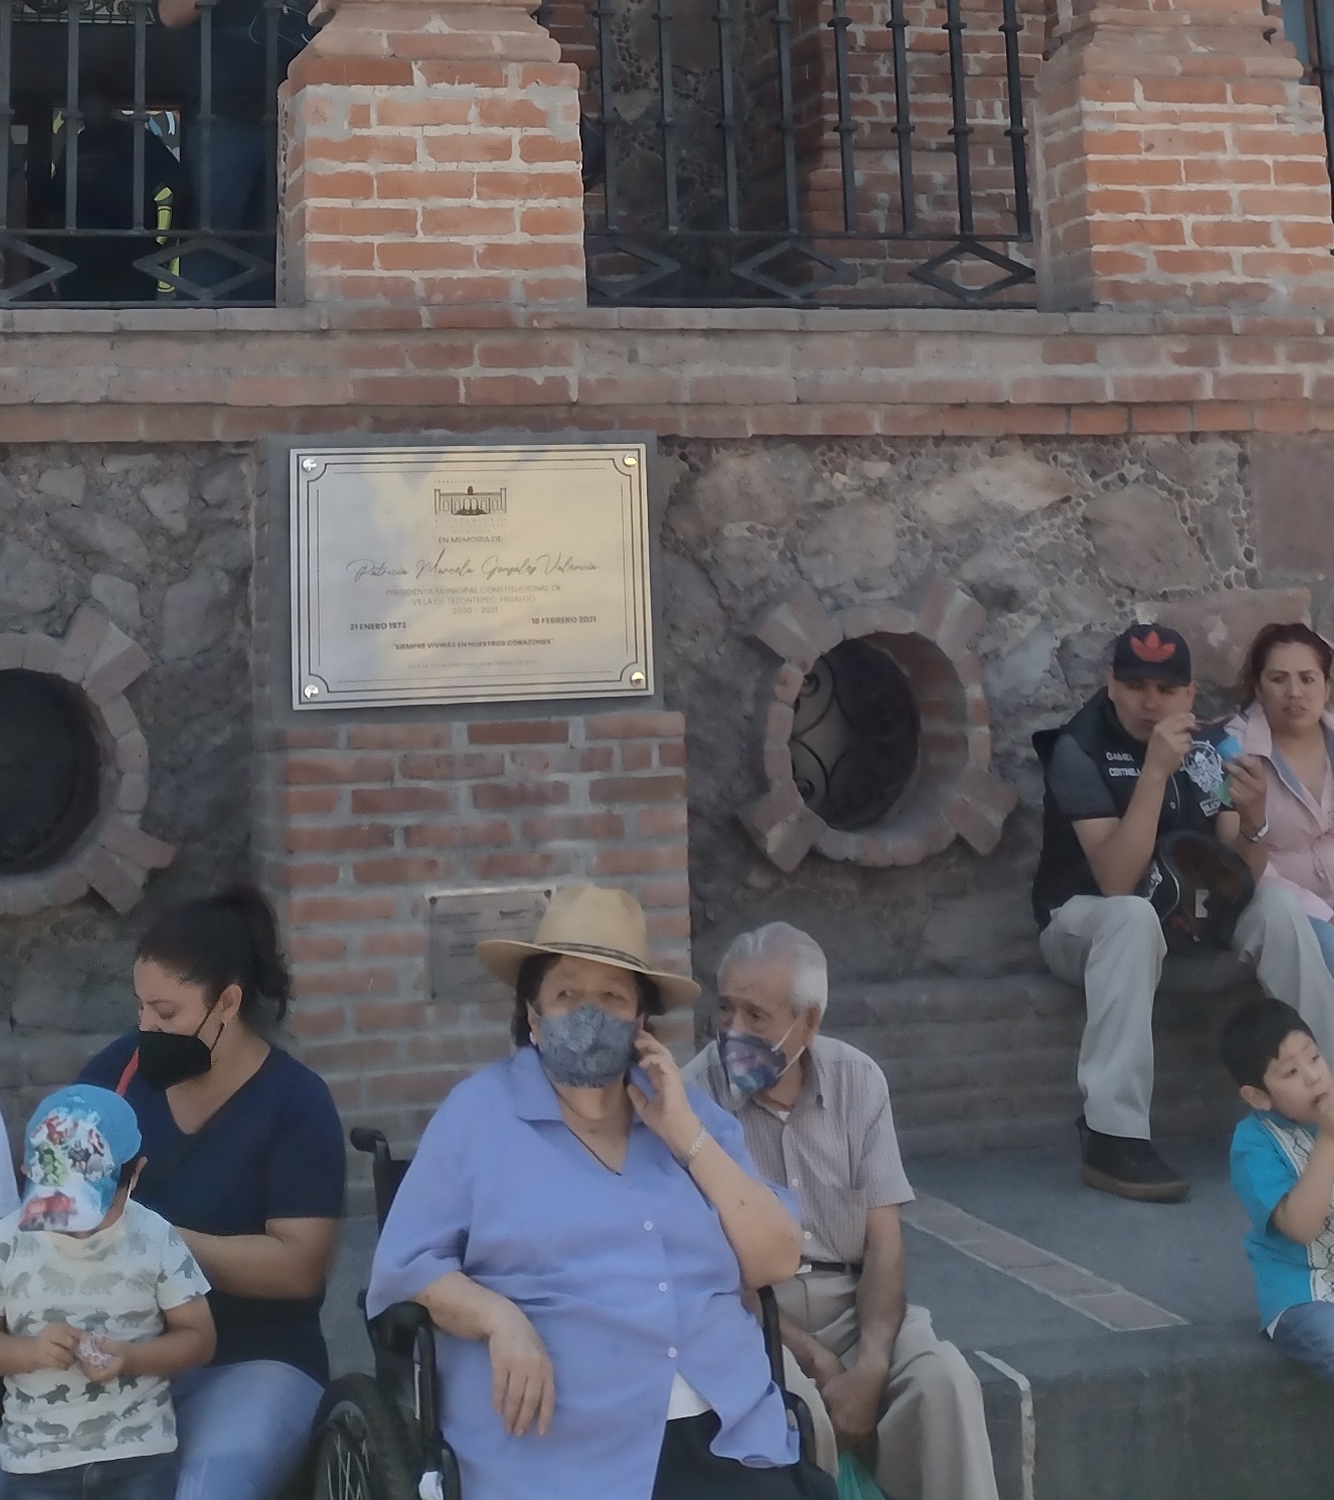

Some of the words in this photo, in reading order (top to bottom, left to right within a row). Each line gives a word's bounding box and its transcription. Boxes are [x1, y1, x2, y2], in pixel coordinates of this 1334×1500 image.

[438, 536, 450, 544] EN
[451, 535, 489, 543] MEMORIA
[491, 535, 502, 543] DE
[346, 559, 408, 582] Patricia
[415, 548, 475, 580] Marcela
[535, 551, 600, 576] Valencia
[541, 615, 578, 624] FEBRERO
[359, 622, 388, 631] ENERO
